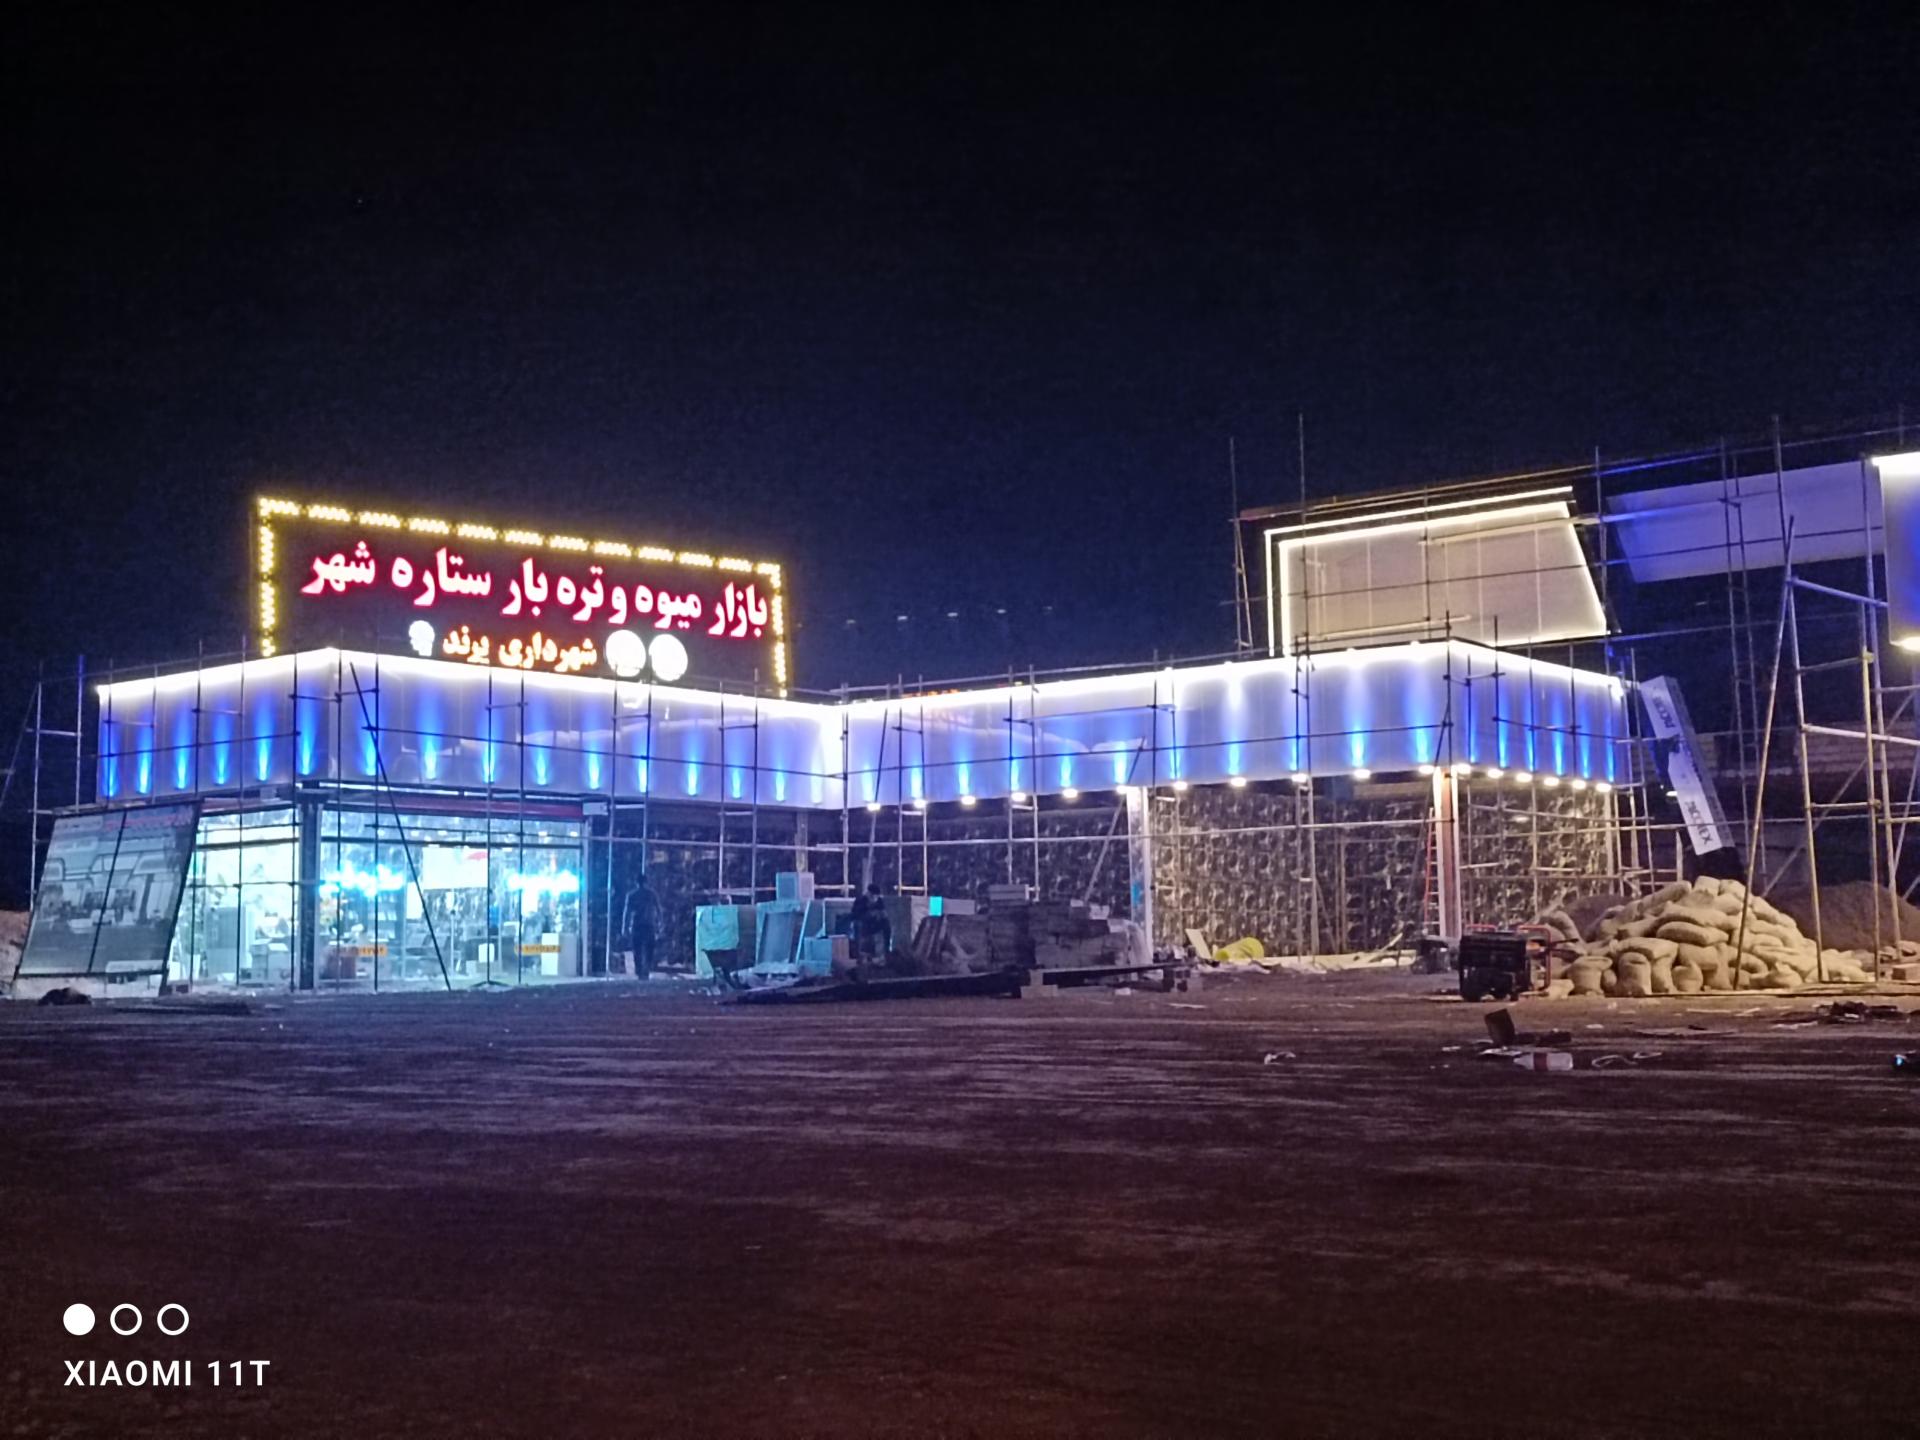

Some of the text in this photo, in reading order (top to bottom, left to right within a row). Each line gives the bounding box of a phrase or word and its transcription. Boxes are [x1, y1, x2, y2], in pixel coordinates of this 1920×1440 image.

[301, 541, 768, 638] بازار میوه و تره بار ستاره شهر
[498, 631, 598, 672] شهرداری
